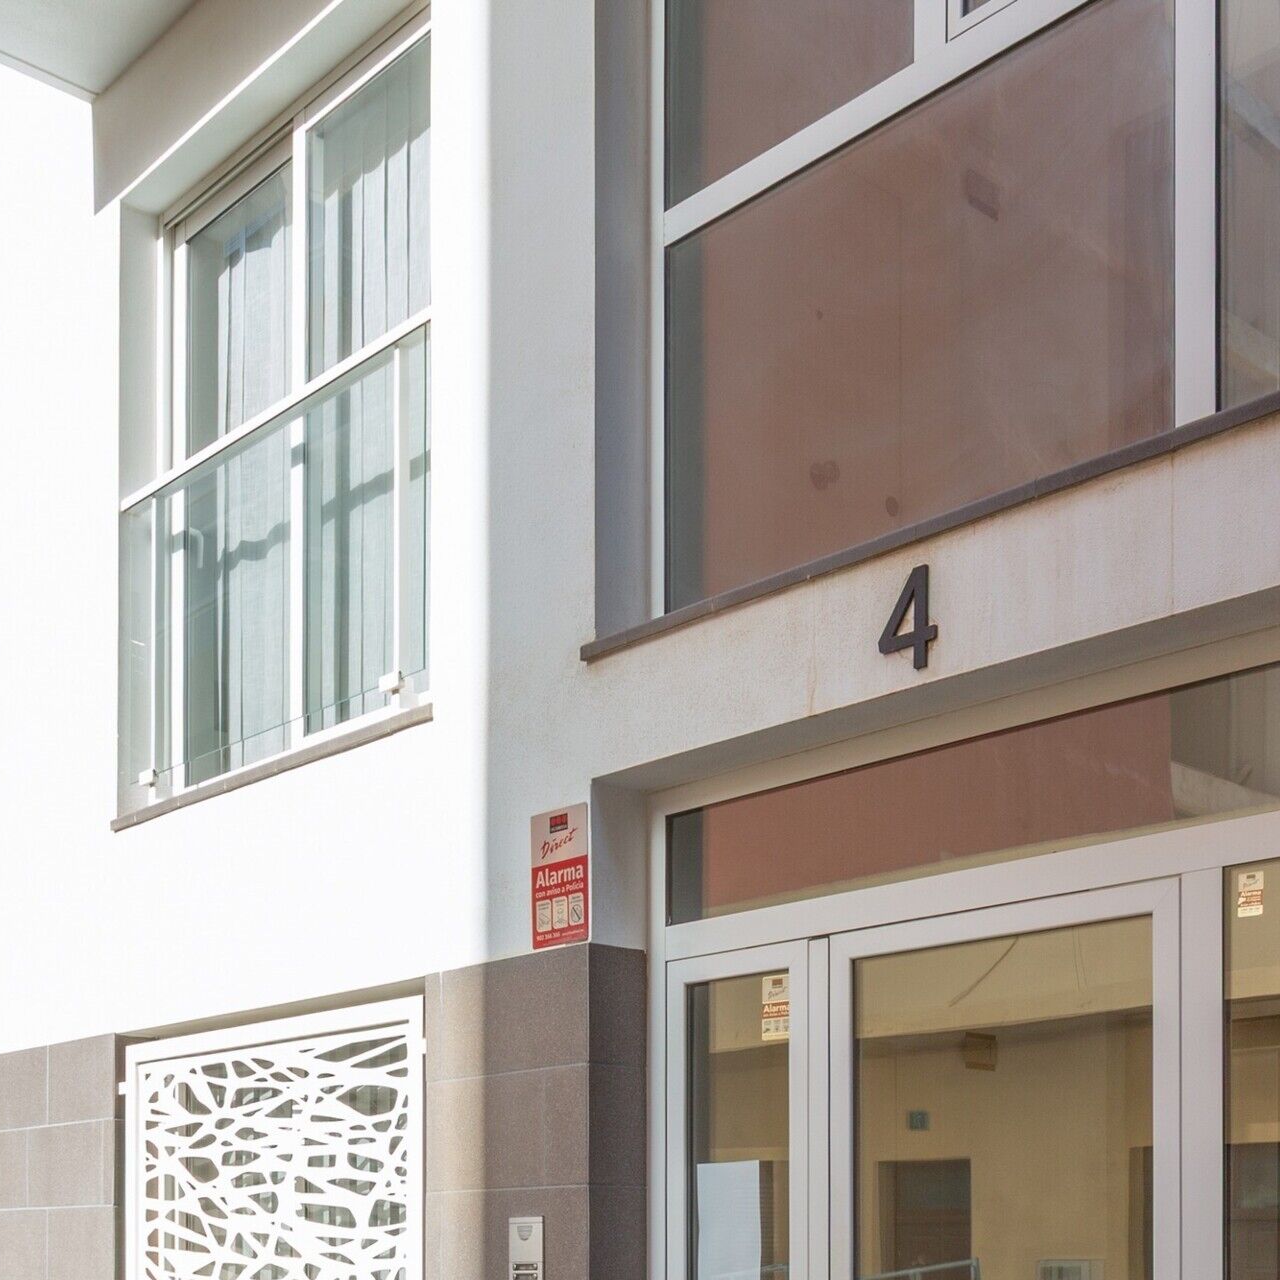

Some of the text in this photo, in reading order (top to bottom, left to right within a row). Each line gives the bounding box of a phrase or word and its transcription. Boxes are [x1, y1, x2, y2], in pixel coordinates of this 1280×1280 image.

[878, 564, 939, 671] 4
[541, 827, 578, 859] Direct
[536, 864, 584, 889] Alarma
